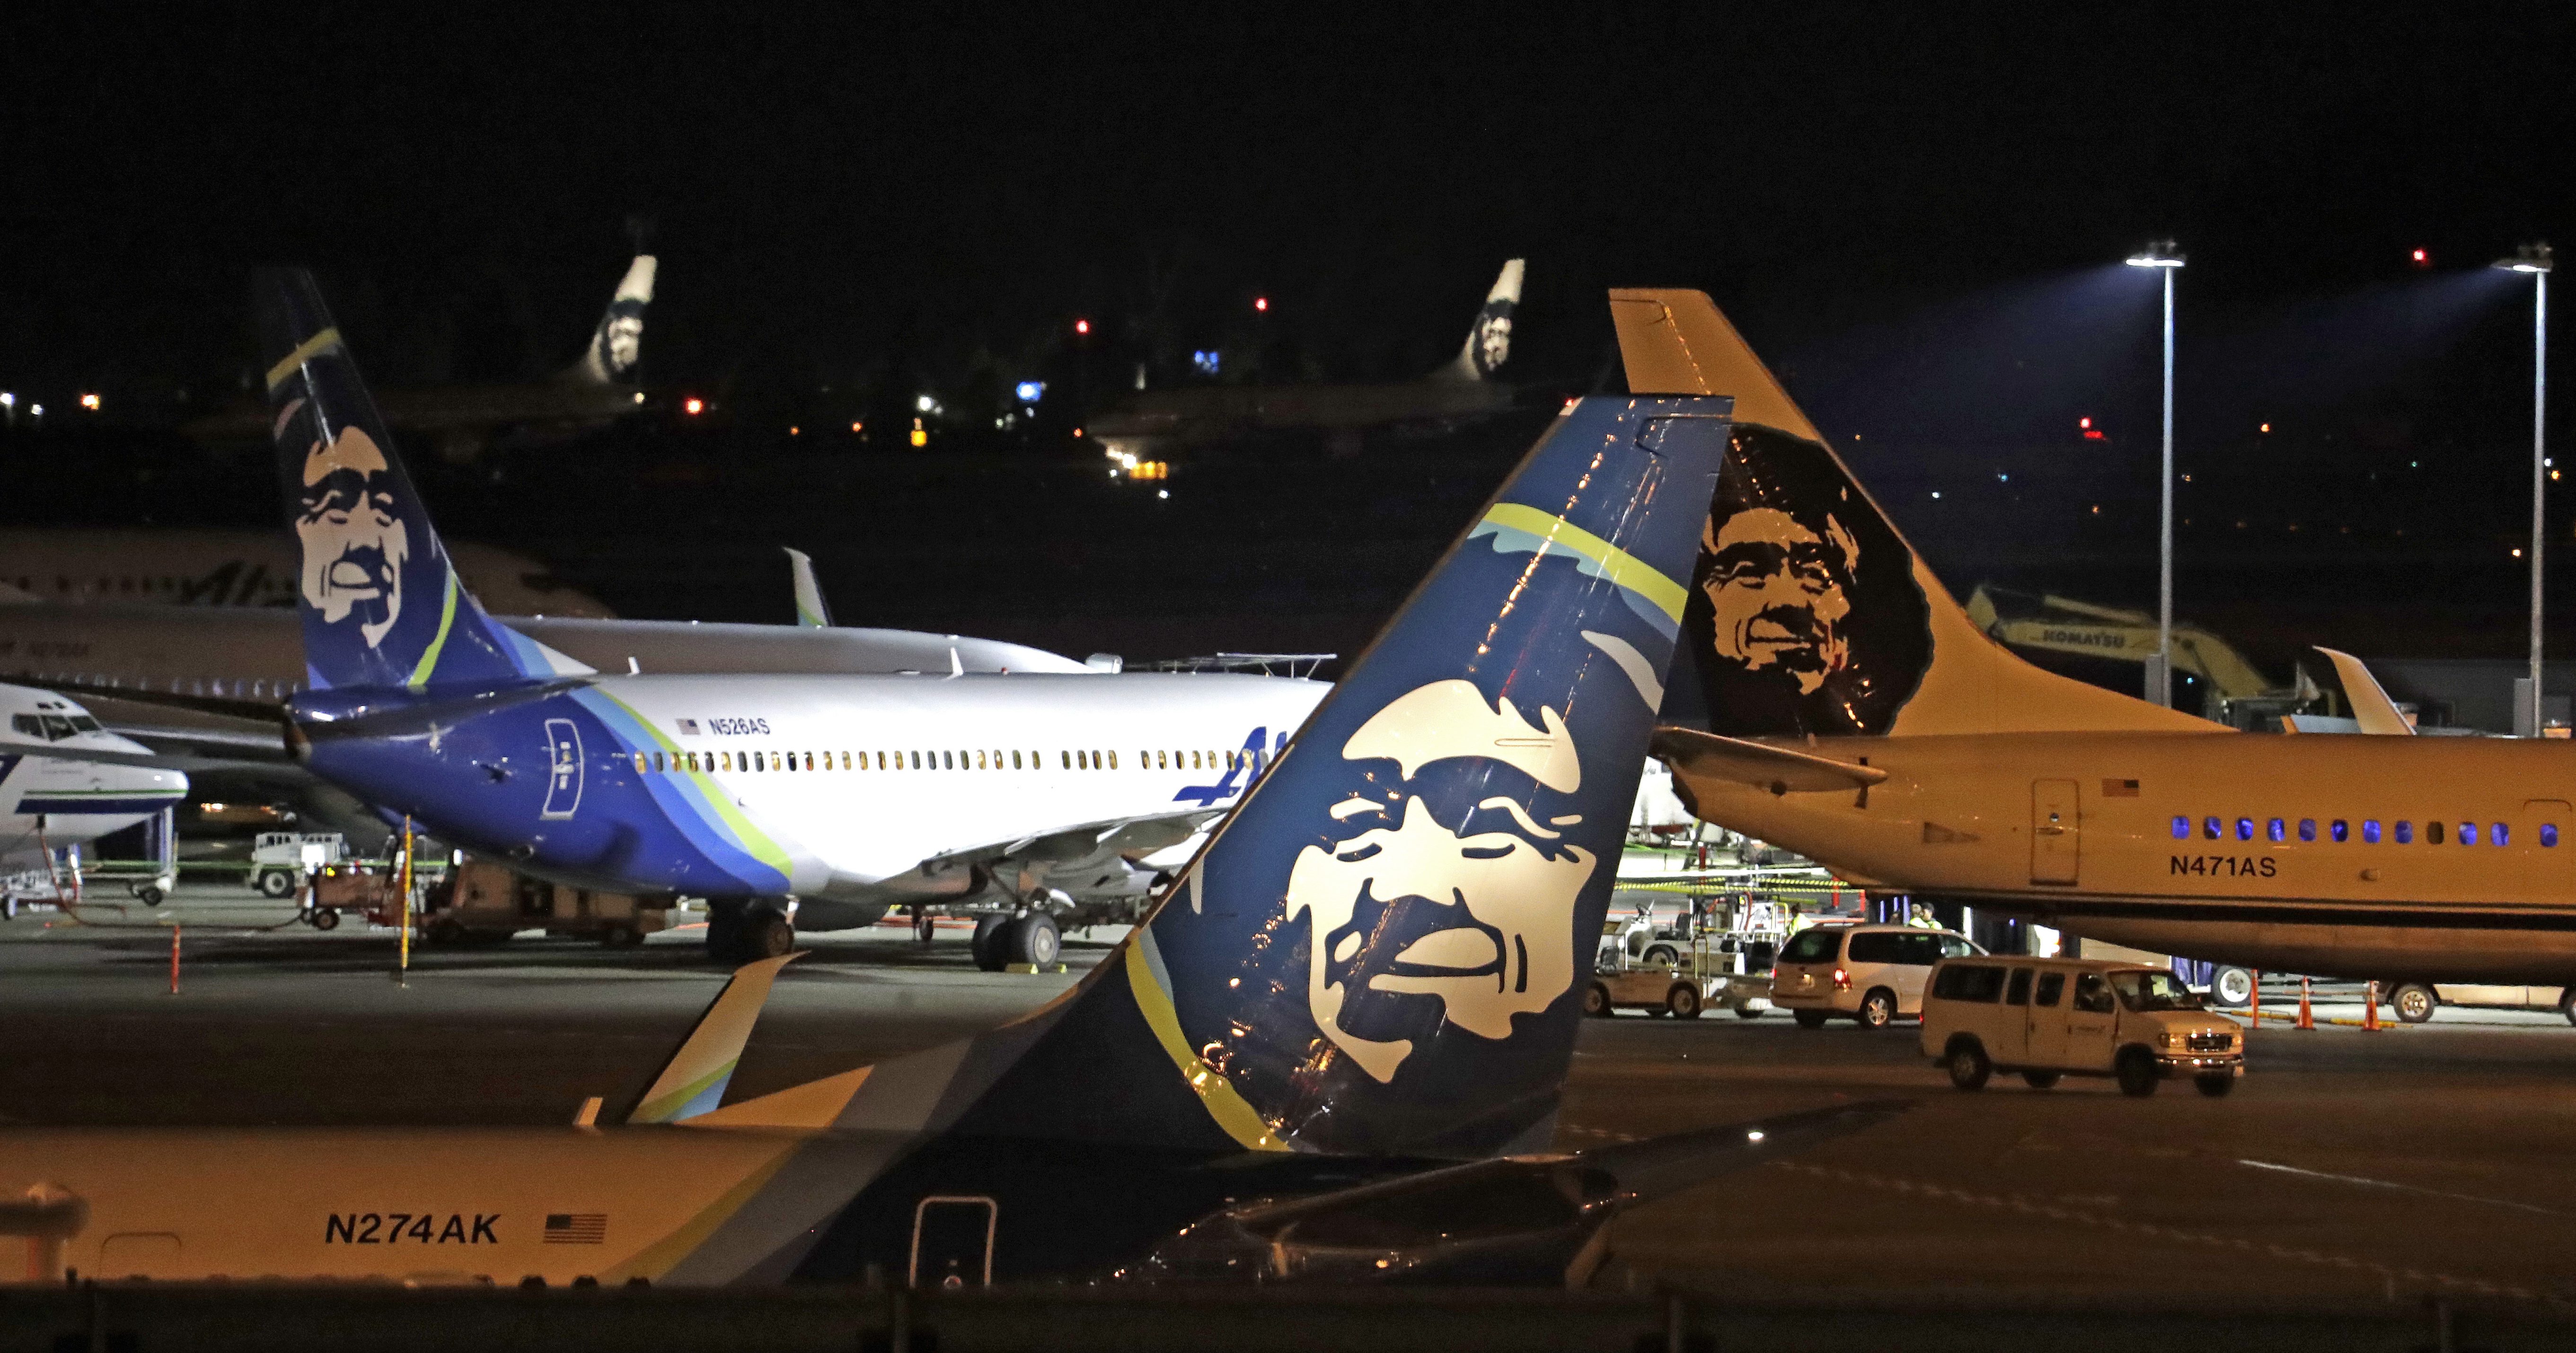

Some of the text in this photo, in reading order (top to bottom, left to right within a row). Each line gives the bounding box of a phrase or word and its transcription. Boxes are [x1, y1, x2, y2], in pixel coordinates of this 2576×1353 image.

[2043, 630, 2125, 647] KOMATSU
[708, 717, 770, 735] N526AS
[2171, 856, 2276, 877] N471AS
[325, 1213, 502, 1244] N274AK
